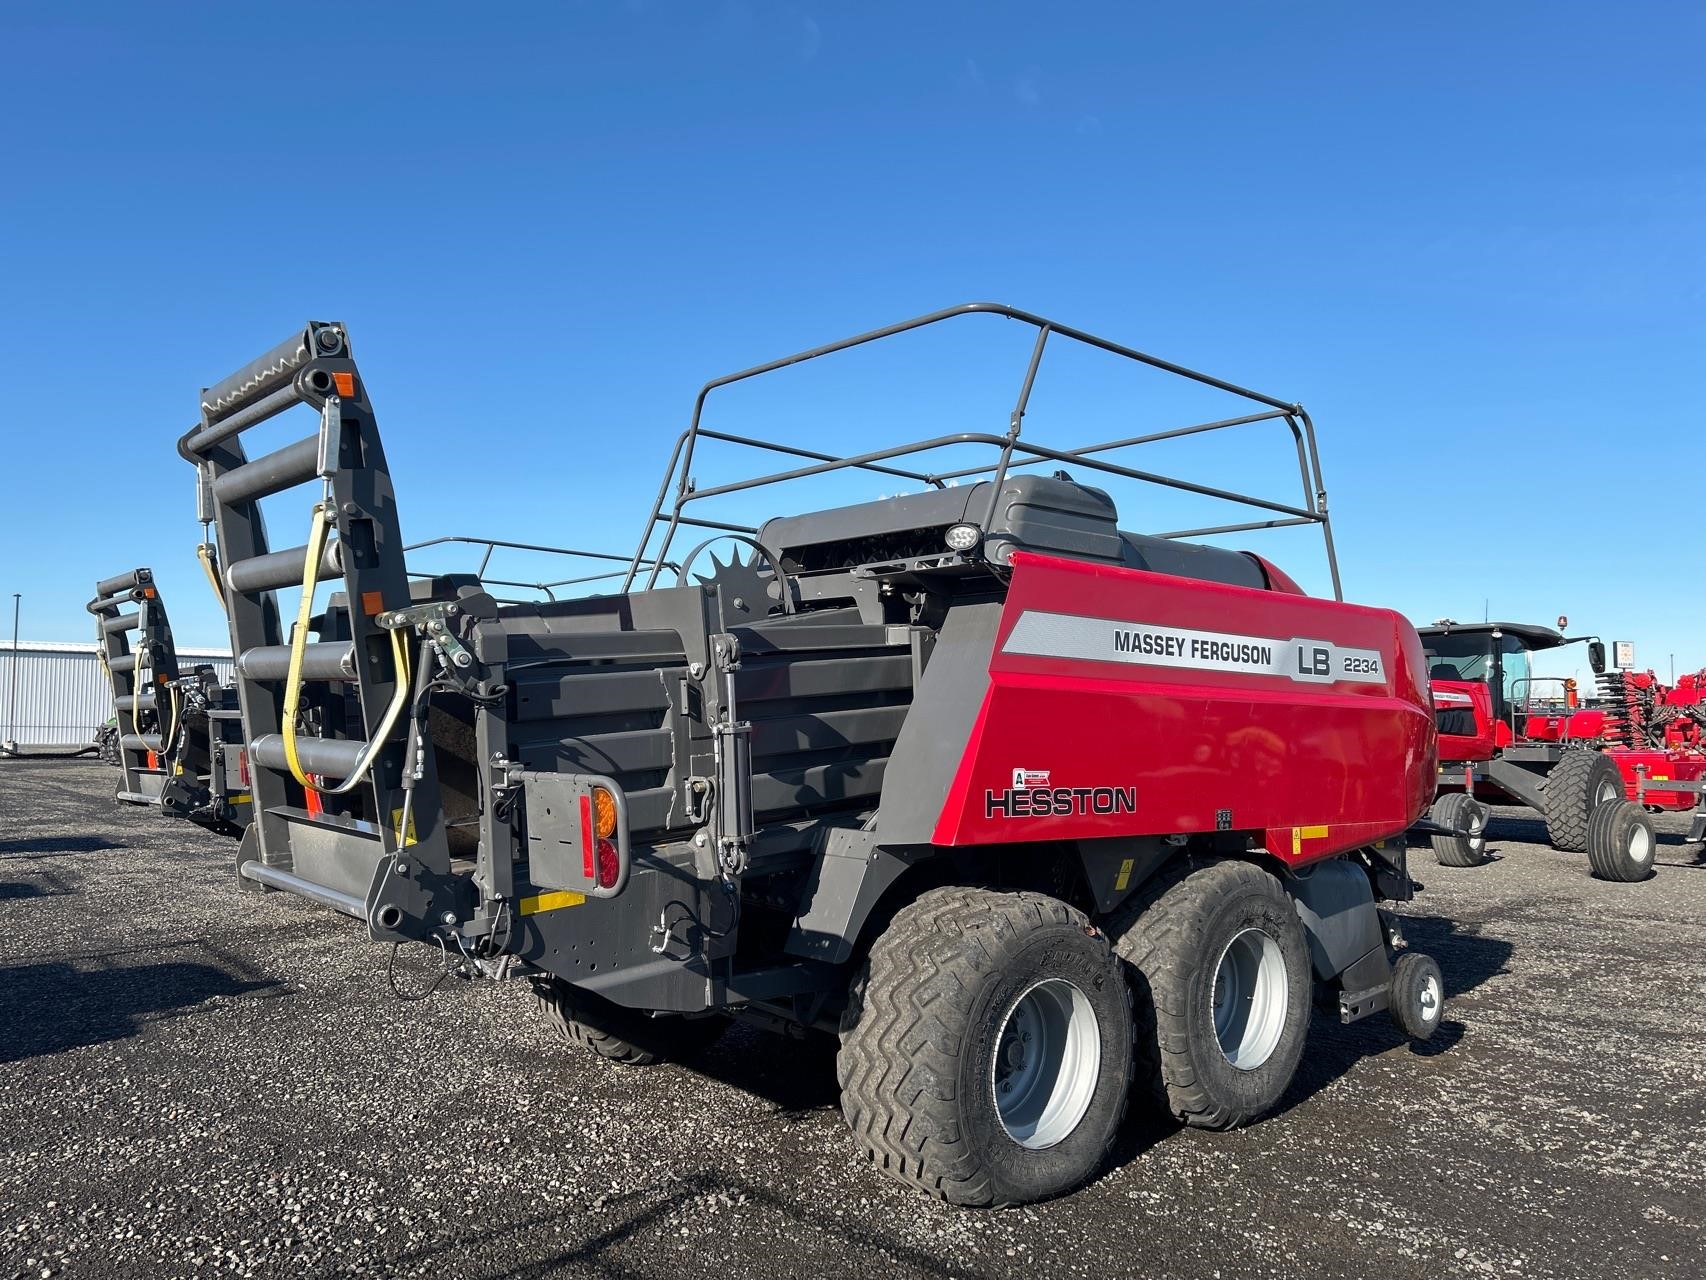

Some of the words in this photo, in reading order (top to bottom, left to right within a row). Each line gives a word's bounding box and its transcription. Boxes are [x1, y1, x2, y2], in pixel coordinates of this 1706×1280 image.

[1113, 630, 1185, 657] MASSEY
[1191, 639, 1271, 665] FERGUSON
[1298, 645, 1331, 676] LB
[1344, 657, 1379, 674] 2234
[985, 787, 1136, 819] HESSTON
